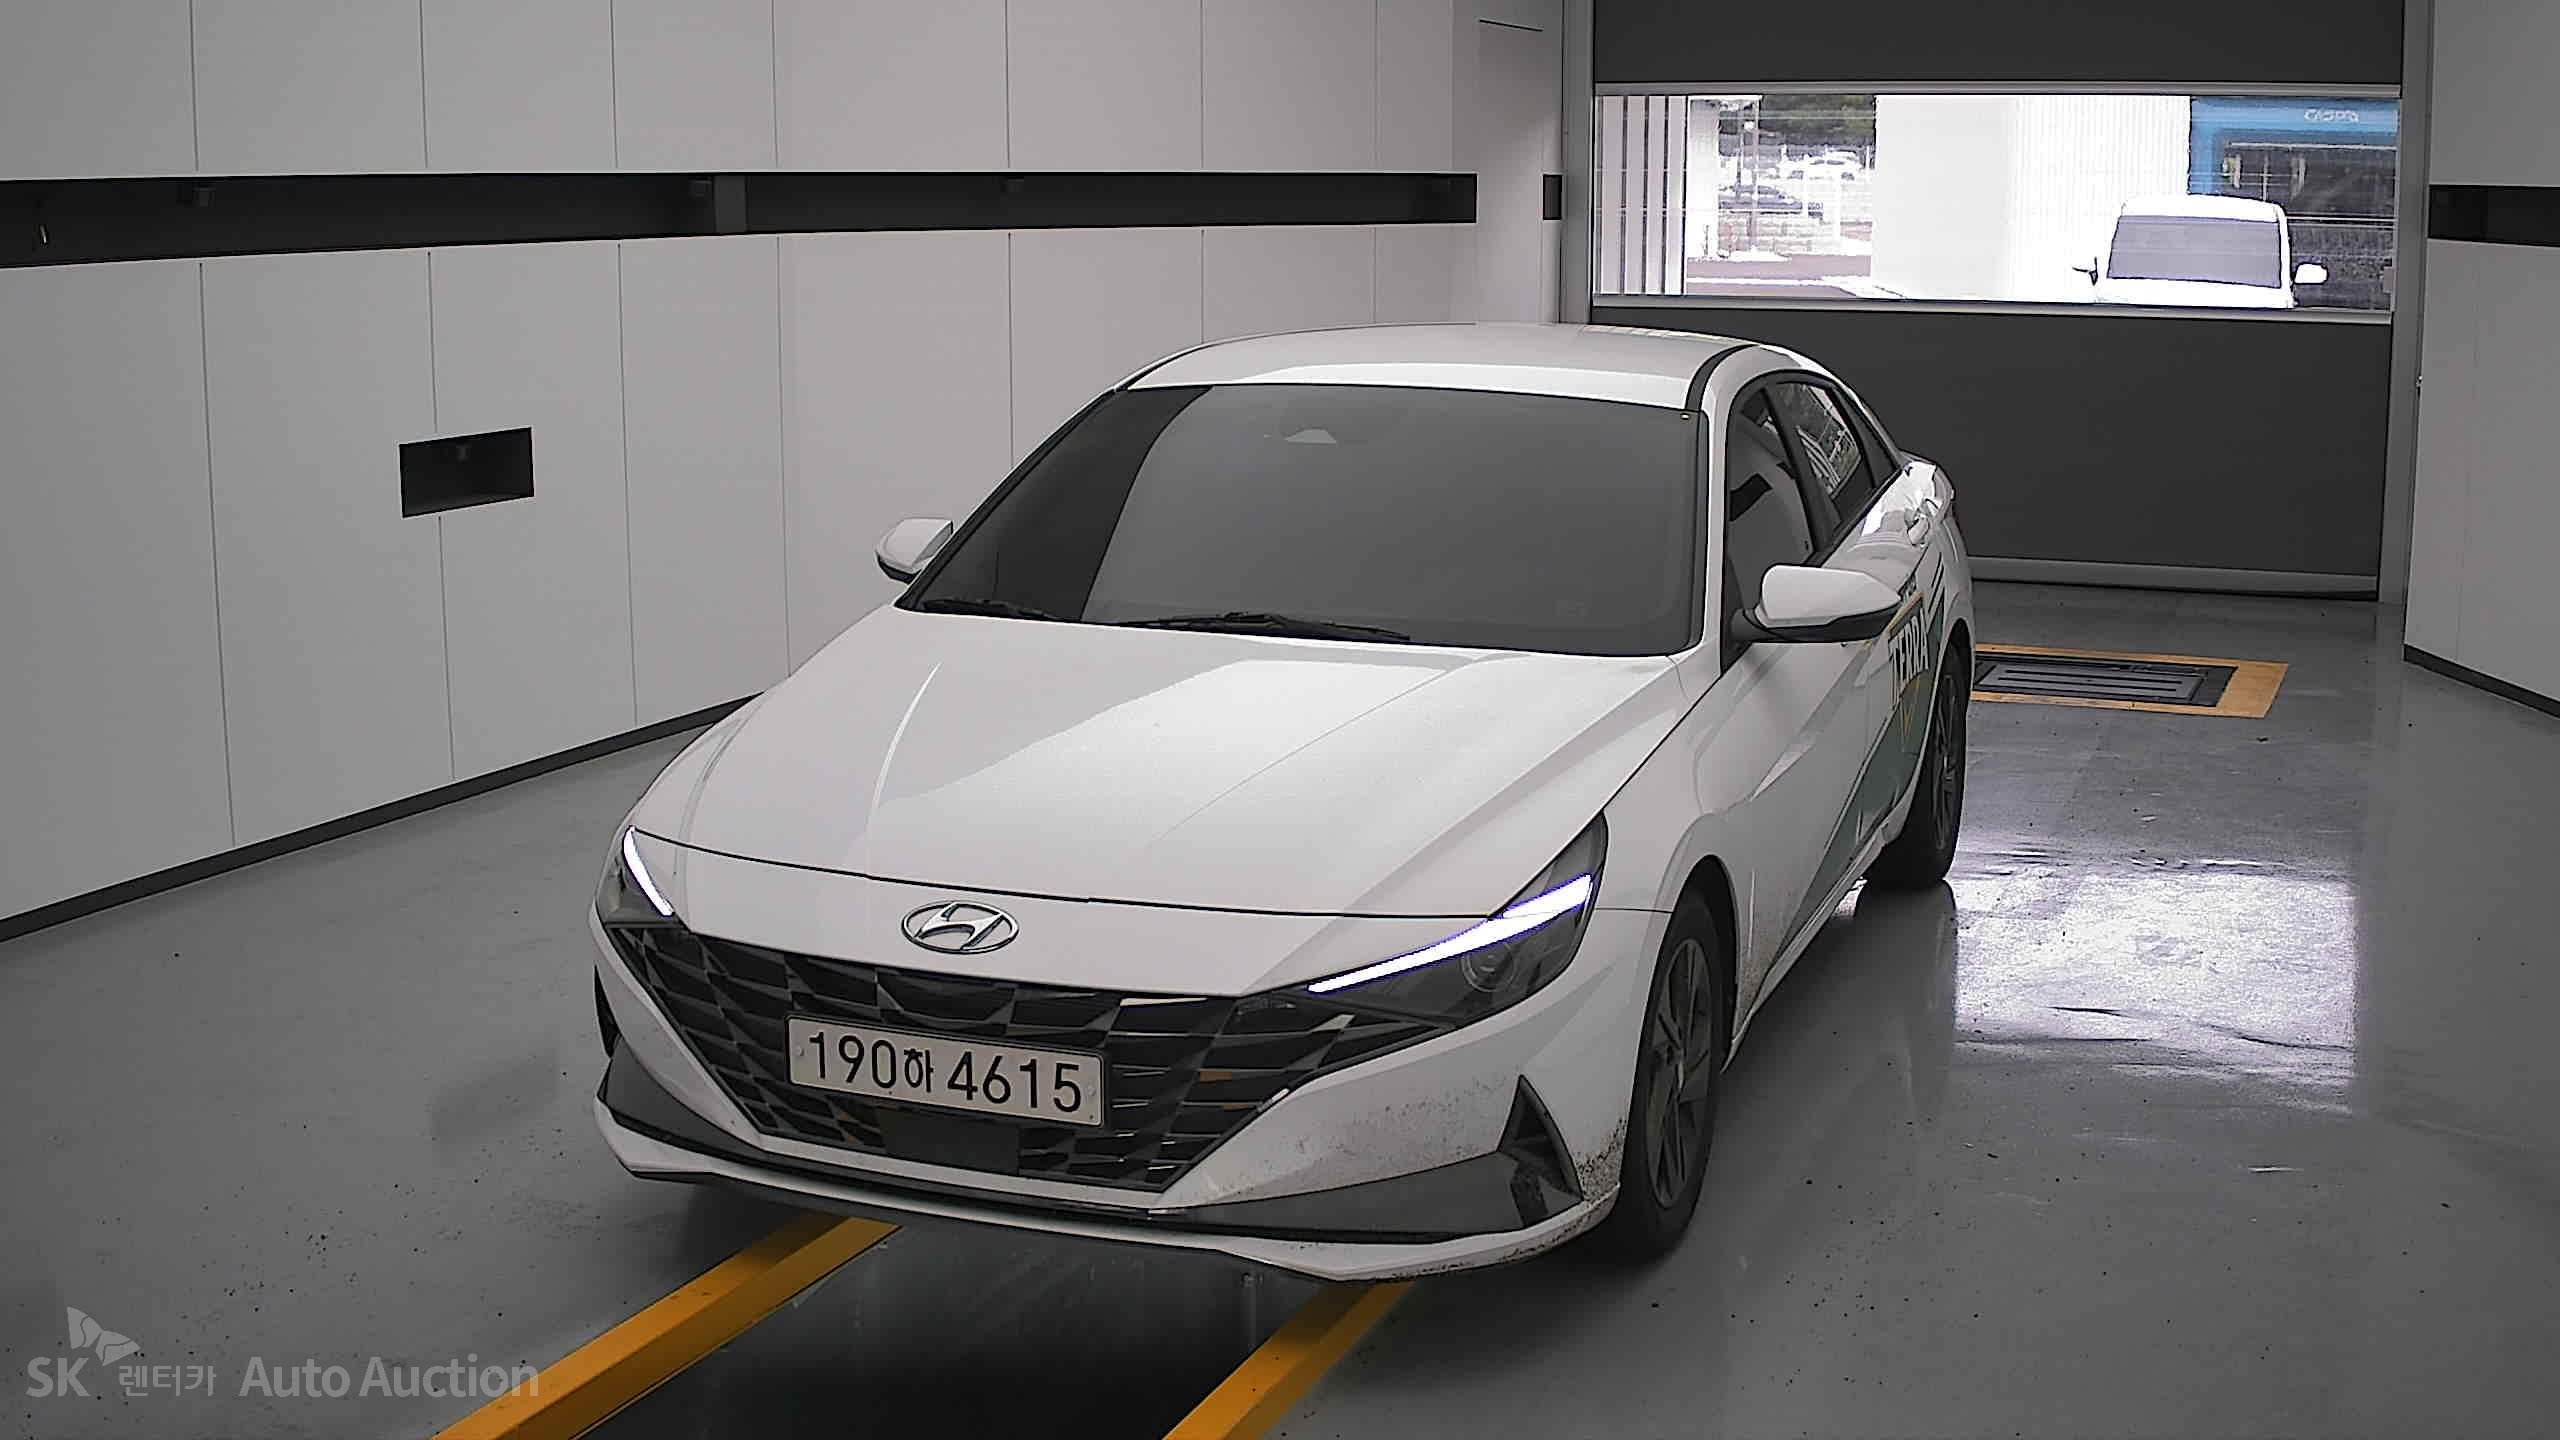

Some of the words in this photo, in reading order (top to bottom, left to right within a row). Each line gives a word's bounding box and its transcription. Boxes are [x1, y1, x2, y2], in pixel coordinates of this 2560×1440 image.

[1889, 608, 1929, 704] TERRA
[809, 1031, 934, 1093] 190하
[947, 1051, 1082, 1113] 4615
